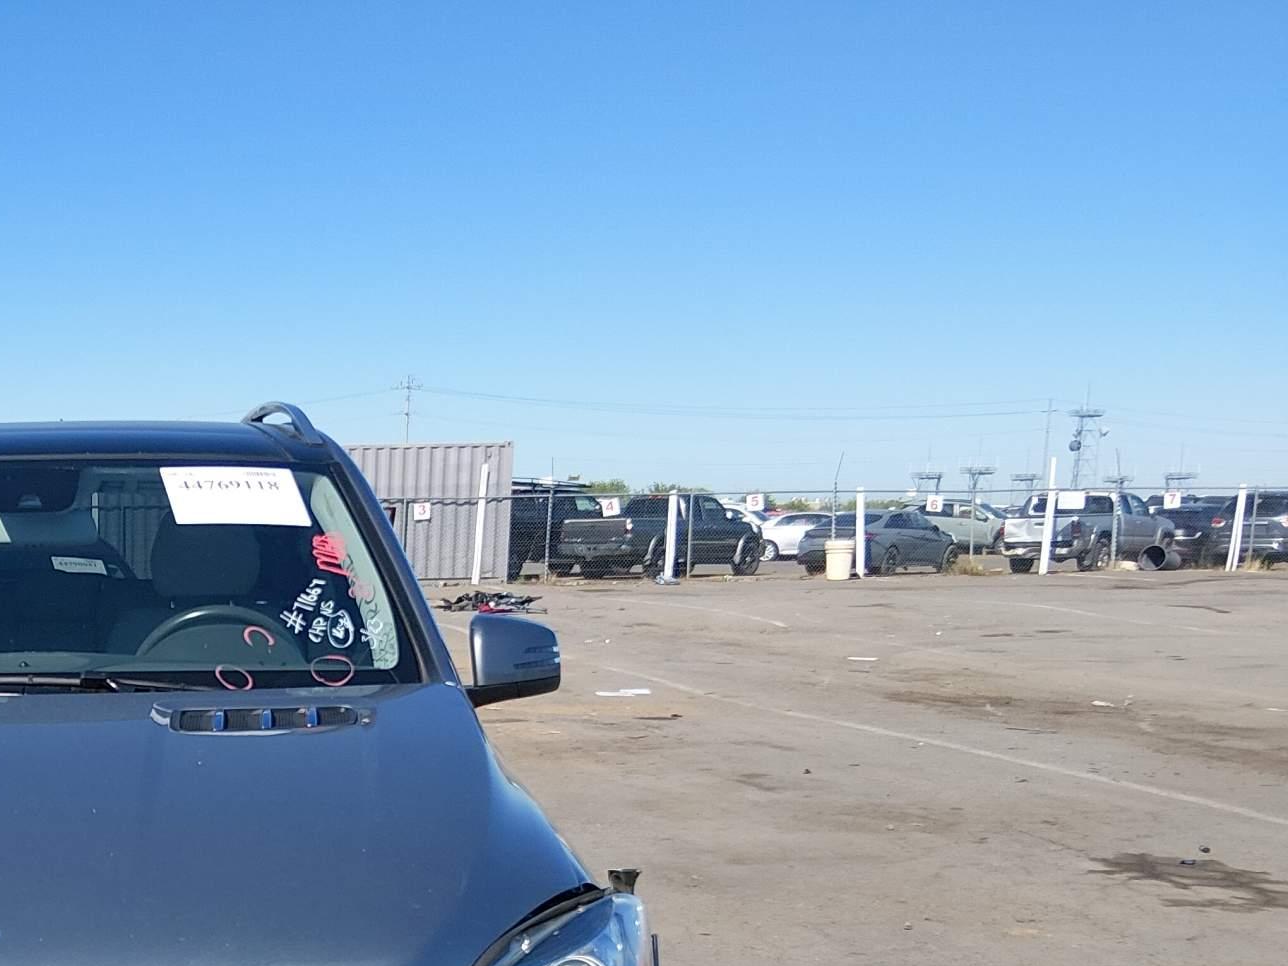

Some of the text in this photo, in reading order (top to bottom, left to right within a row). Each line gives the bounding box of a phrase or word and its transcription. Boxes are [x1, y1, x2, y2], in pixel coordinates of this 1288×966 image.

[751, 496, 759, 507] 5
[1168, 493, 1177, 505] 7
[418, 504, 426, 516] 3
[605, 501, 614, 512] 4
[930, 500, 938, 510] 6
